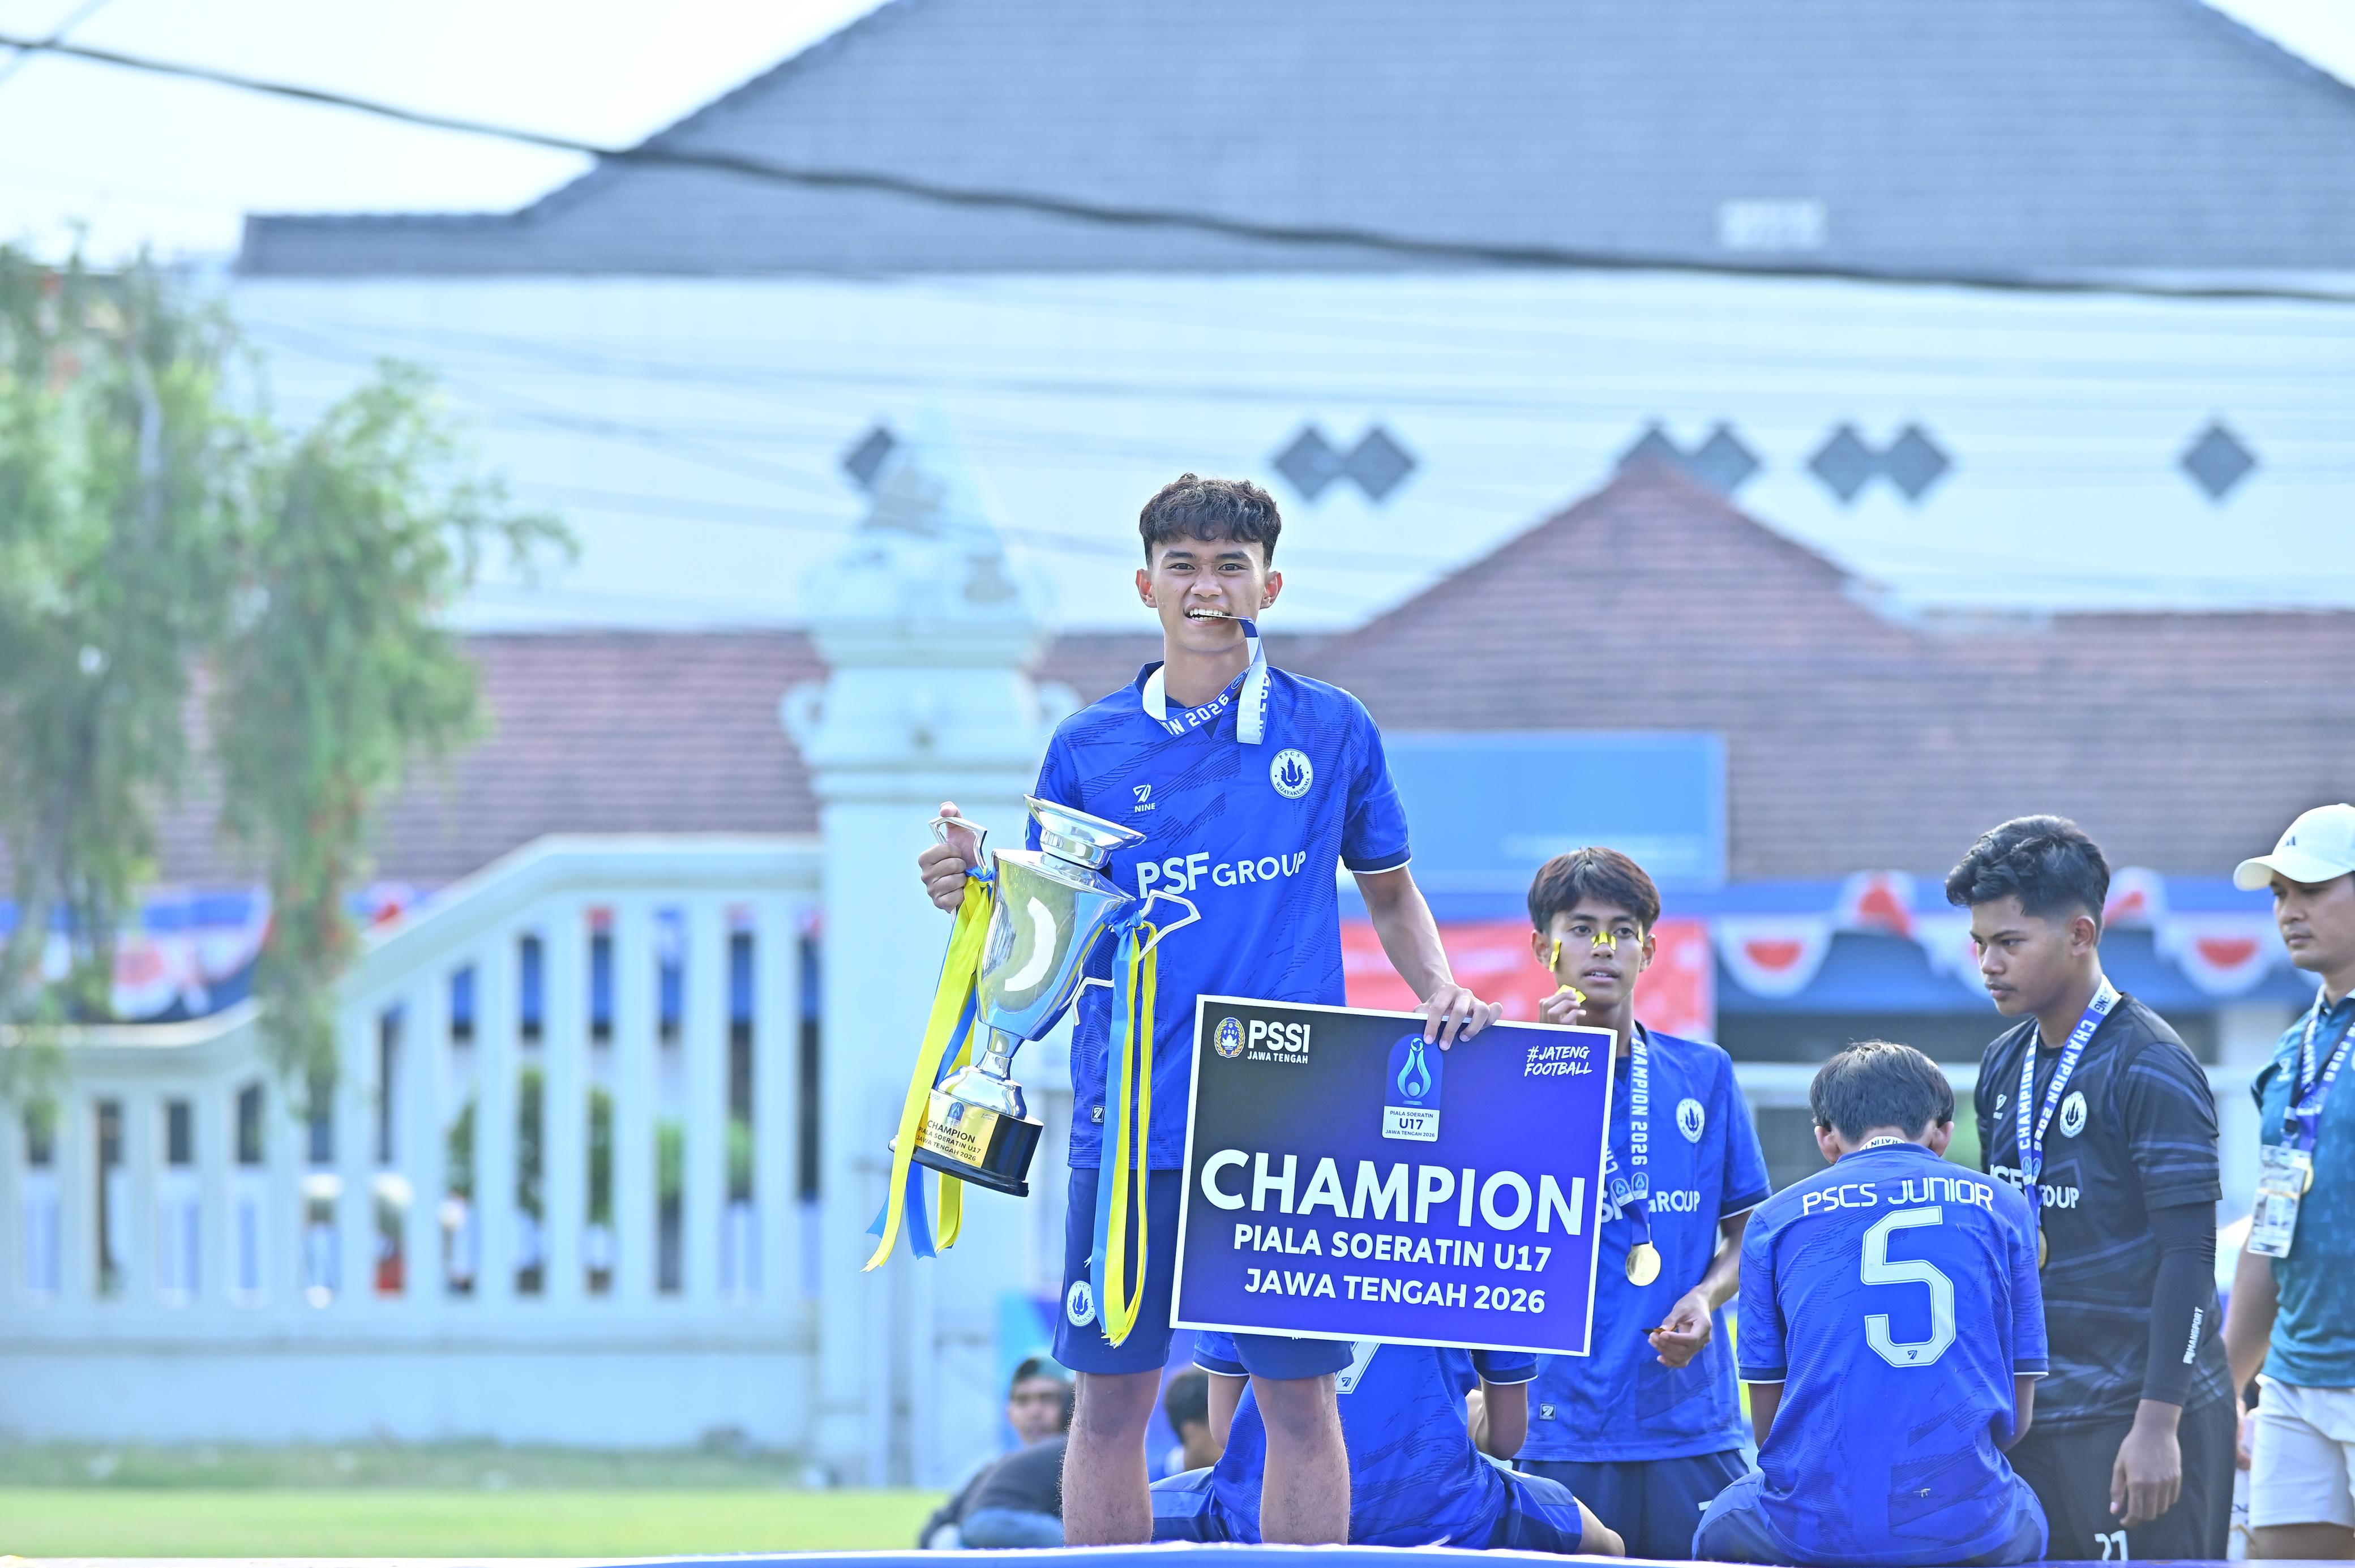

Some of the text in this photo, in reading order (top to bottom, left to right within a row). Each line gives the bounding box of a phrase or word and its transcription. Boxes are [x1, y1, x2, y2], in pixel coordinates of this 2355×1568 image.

[1185, 693, 1229, 727] 2026
[1279, 751, 1301, 760] PSCS
[1276, 778, 1311, 796] WIJAYAKUSUMA
[1134, 802, 1155, 813] NINE
[1136, 850, 1307, 899] PSF GROUP
[1248, 1019, 1311, 1053] PSSI
[1247, 1051, 1308, 1064] JAWA TENGAH
[1524, 1061, 1593, 1077] FOOTBALL
[1527, 1045, 1591, 1063] #JATENG
[2046, 1019, 2097, 1104] CHAMPION
[1631, 1036, 1648, 1166] CHAMPION 2026
[2018, 1059, 2035, 1150] CHAMPION
[918, 1126, 981, 1154] PIALA SOERATIN U17
[927, 1120, 976, 1143] CHAMPION
[1399, 1117, 1424, 1130] U17
[916, 1135, 977, 1161] JAWA TENGAH 2026
[1200, 1149, 1586, 1236] CHAMPION
[1802, 1177, 1994, 1216] PSCS JUNIOR
[1234, 1223, 1552, 1273] PIALA SOERATIN U17
[1244, 1268, 1545, 1314] JAWA TENGAH 2026
[1860, 1205, 1956, 1368] 5
